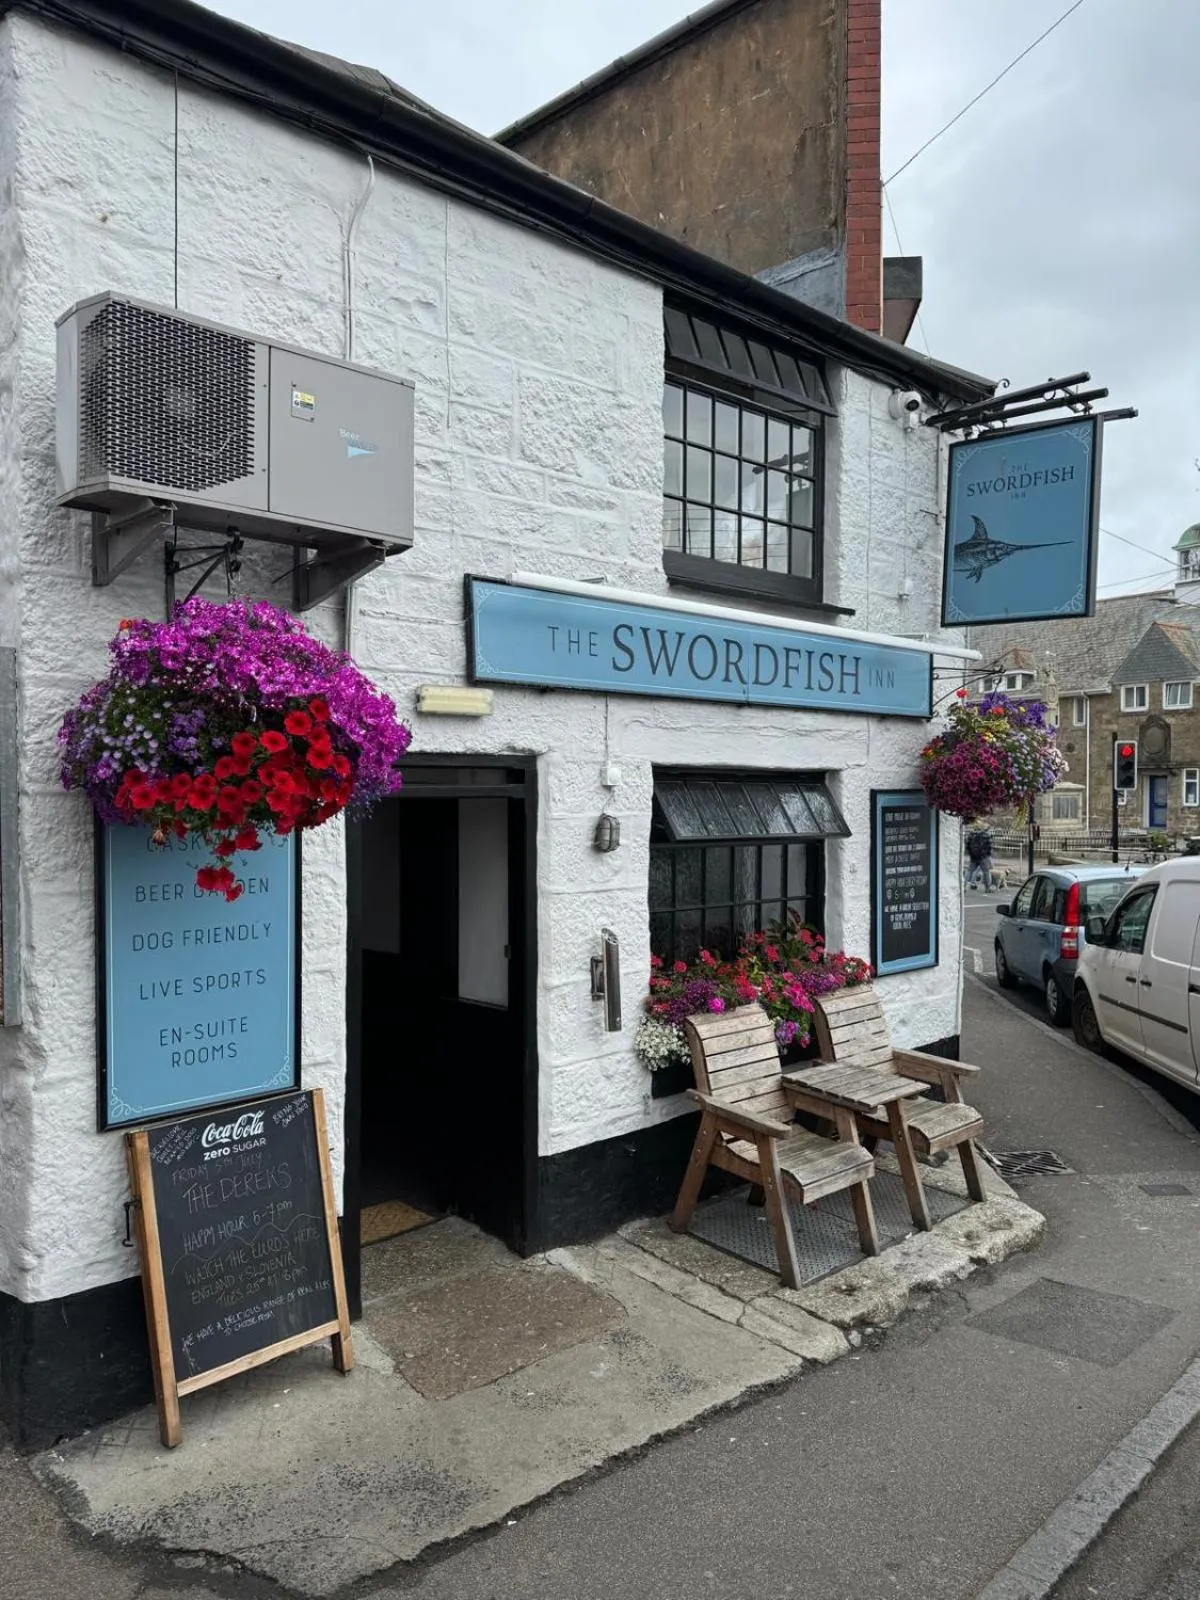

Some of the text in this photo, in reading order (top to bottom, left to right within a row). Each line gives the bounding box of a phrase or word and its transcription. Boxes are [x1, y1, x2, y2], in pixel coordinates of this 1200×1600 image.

[966, 465, 1075, 497] SWORDFISH
[547, 624, 895, 695] THE SWORDFISH INN
[135, 883, 184, 902] BEER
[132, 922, 272, 952] DOG FRIENDLY
[140, 969, 266, 1000] LIVE SPORTS
[160, 1016, 249, 1047] EN-SUITE
[171, 1042, 238, 1068] ROOMS
[201, 1110, 265, 1148] Coca-Cola
[203, 1147, 230, 1161] zero
[232, 1137, 267, 1153] SUGAR
[172, 1163, 209, 1186] FRIDAY
[182, 1161, 293, 1215] THE DEREKS
[183, 1225, 216, 1253] HAPPY
[218, 1215, 249, 1237] HOUR
[185, 1254, 224, 1285] WATCH
[225, 1247, 249, 1267] THE
[293, 1226, 321, 1244] HERE
[192, 1273, 236, 1305] ENGLAND
[246, 1251, 297, 1279] SLOVENIA
[224, 1306, 262, 1328] DELICIOUS
